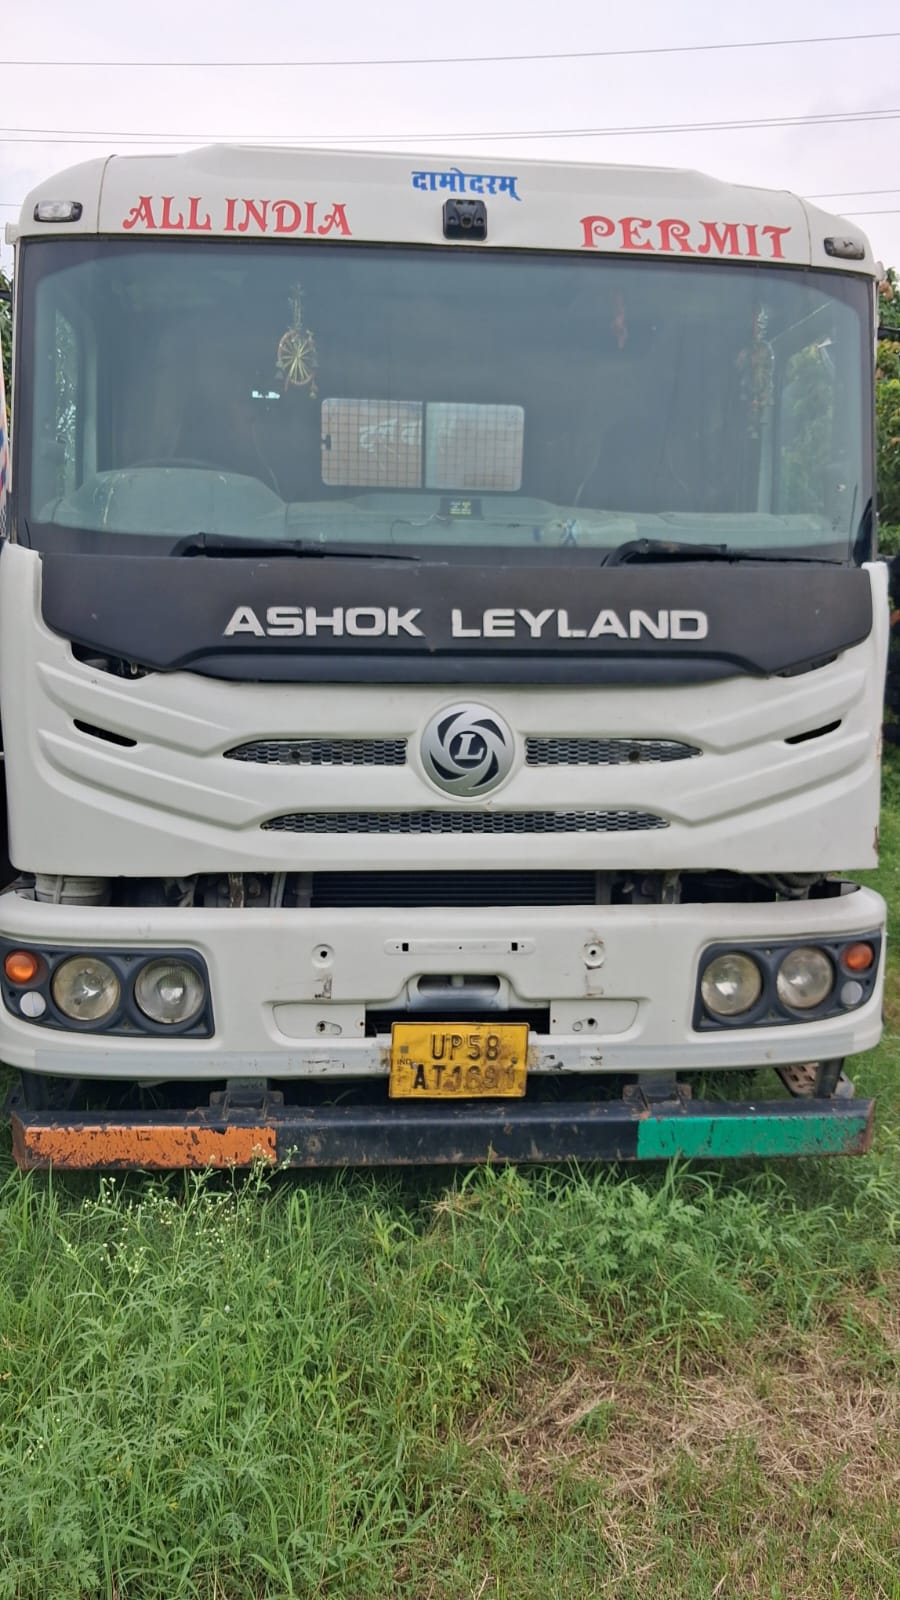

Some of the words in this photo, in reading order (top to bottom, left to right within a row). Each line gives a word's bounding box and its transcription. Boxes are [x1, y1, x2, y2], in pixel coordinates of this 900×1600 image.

[411, 167, 521, 201] दामोदरम्
[122, 195, 212, 230] ALL
[224, 198, 352, 236] INDIA
[579, 215, 792, 259] PERMIT
[223, 606, 425, 637] ASHOK
[452, 608, 709, 640] LEYLAND
